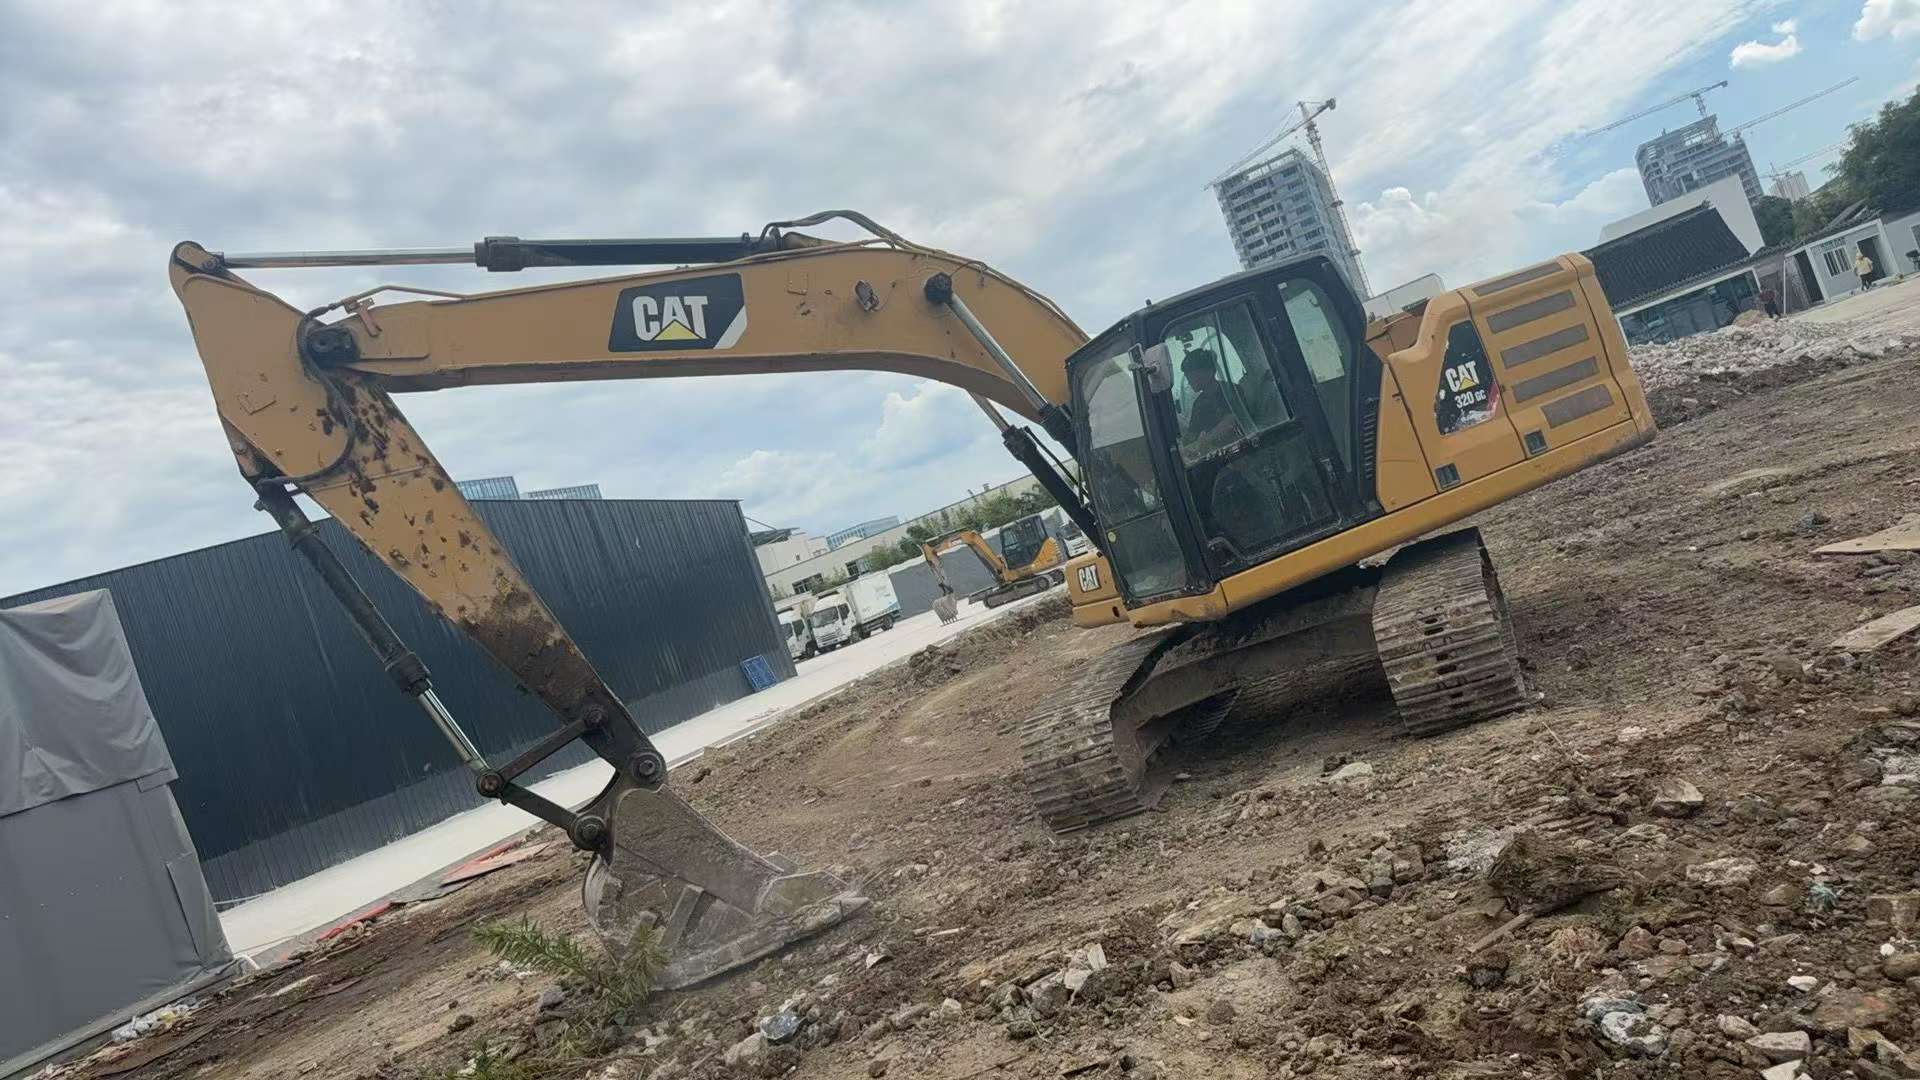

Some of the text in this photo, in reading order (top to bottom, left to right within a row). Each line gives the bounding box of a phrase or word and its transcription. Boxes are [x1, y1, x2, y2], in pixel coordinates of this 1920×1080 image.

[632, 295, 708, 341] CAT
[1445, 360, 1480, 392] CAT
[1454, 391, 1475, 409] 320
[1078, 565, 1101, 592] CAT
